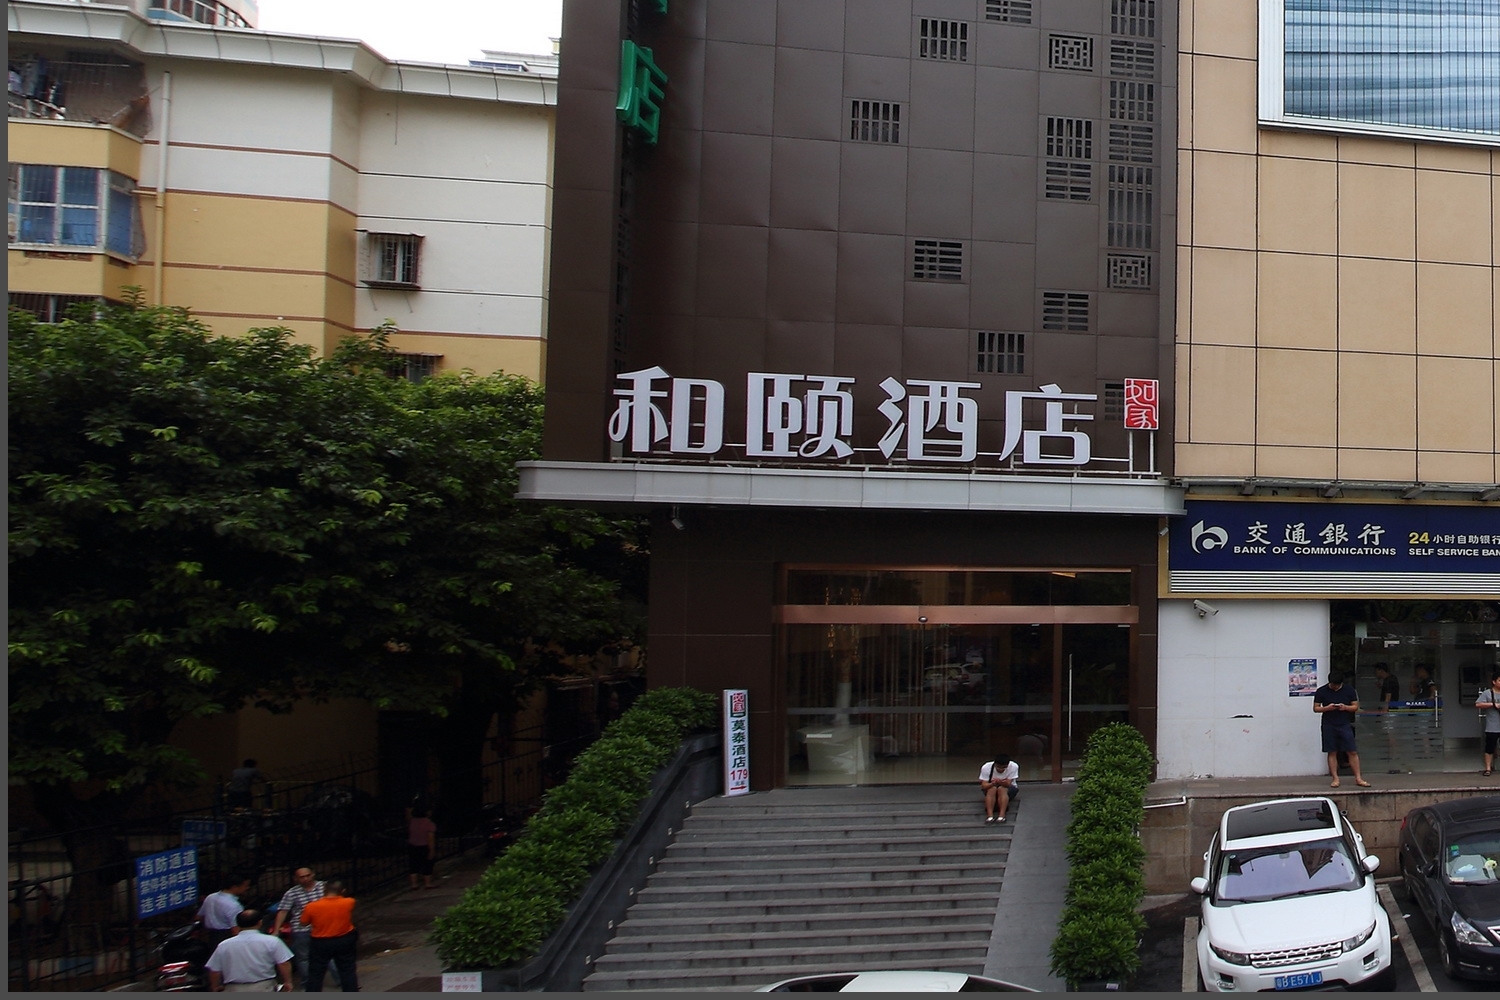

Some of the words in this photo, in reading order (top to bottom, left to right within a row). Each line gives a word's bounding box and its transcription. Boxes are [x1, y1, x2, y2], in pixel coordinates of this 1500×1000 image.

[609, 366, 1098, 466] 和颐酒店
[1245, 520, 1387, 546] 交通銀行
[1233, 546, 1266, 555] BANK
[1272, 546, 1288, 555] OF
[1294, 546, 1397, 557] COMMUNICATIONS
[1409, 548, 1435, 557] SELF
[1437, 548, 1480, 557] SERVICE
[731, 719, 747, 769] 莫泰酒店
[730, 768, 748, 780] 179
[140, 849, 196, 877] 消防通道
[140, 867, 197, 896] 禁停各种车辆
[141, 885, 197, 914] 违者拖走
